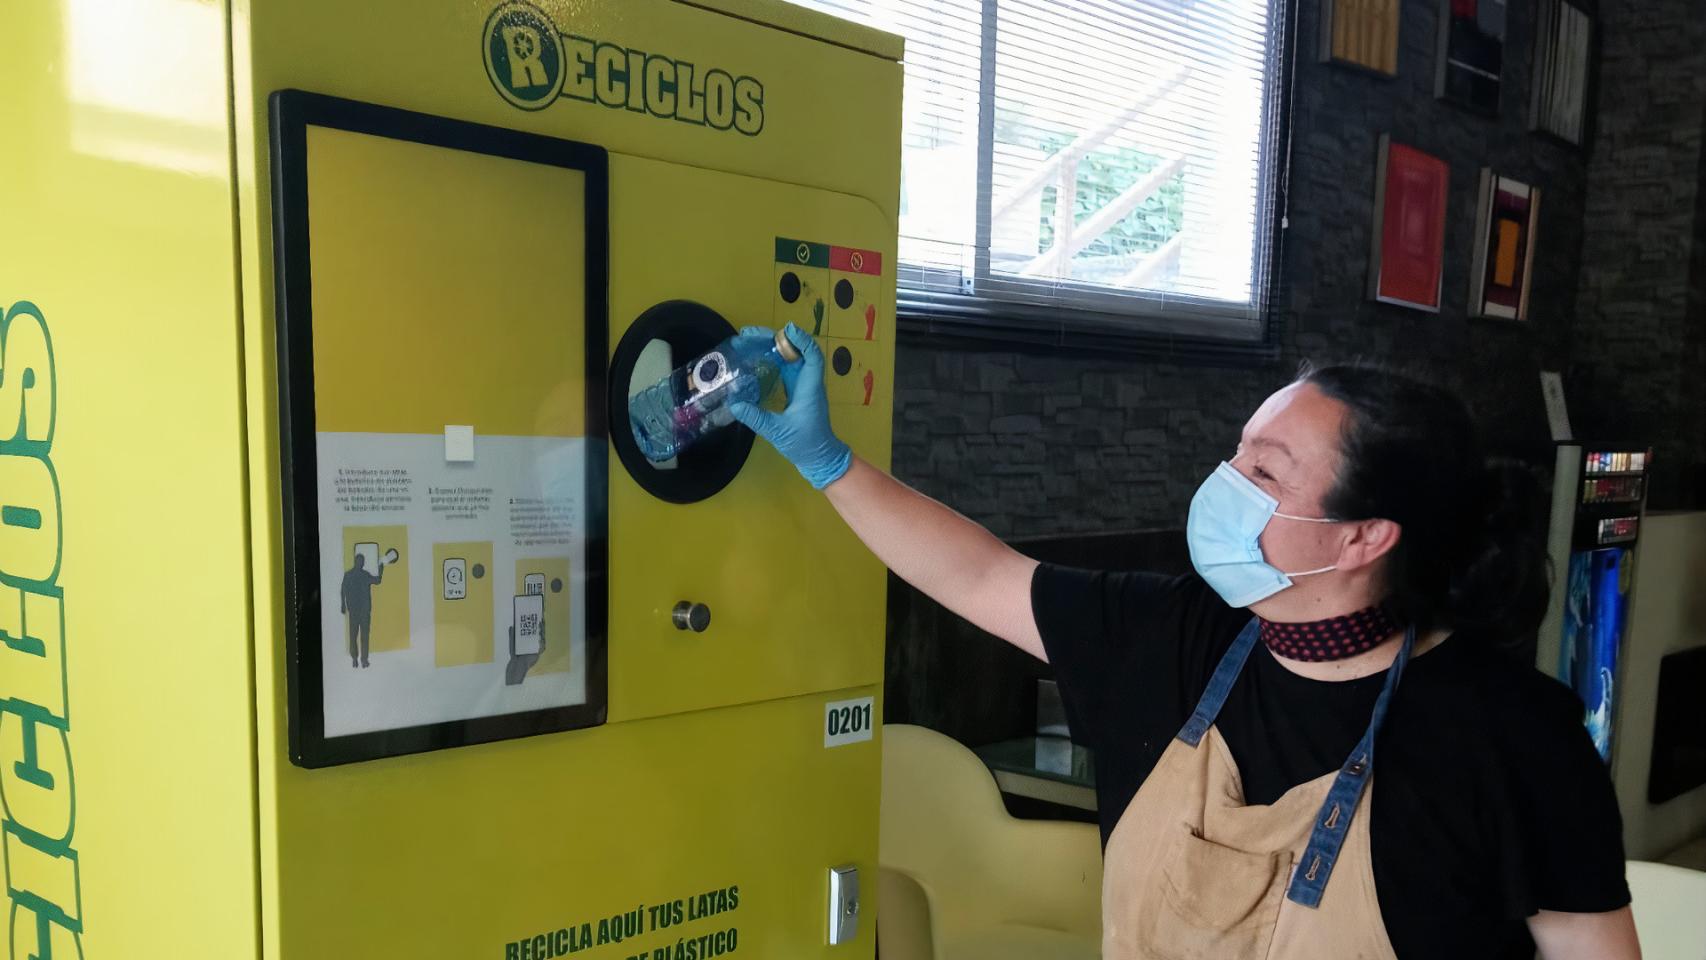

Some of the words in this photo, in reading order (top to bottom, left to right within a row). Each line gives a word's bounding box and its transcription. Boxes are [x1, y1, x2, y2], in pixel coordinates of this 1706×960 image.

[500, 24, 764, 136] RECICLOS
[828, 703, 871, 736] 0201
[505, 923, 593, 960] RECICLA
[596, 905, 644, 943] AQUÍ
[648, 900, 683, 931] TUS
[688, 885, 739, 921] LATAS
